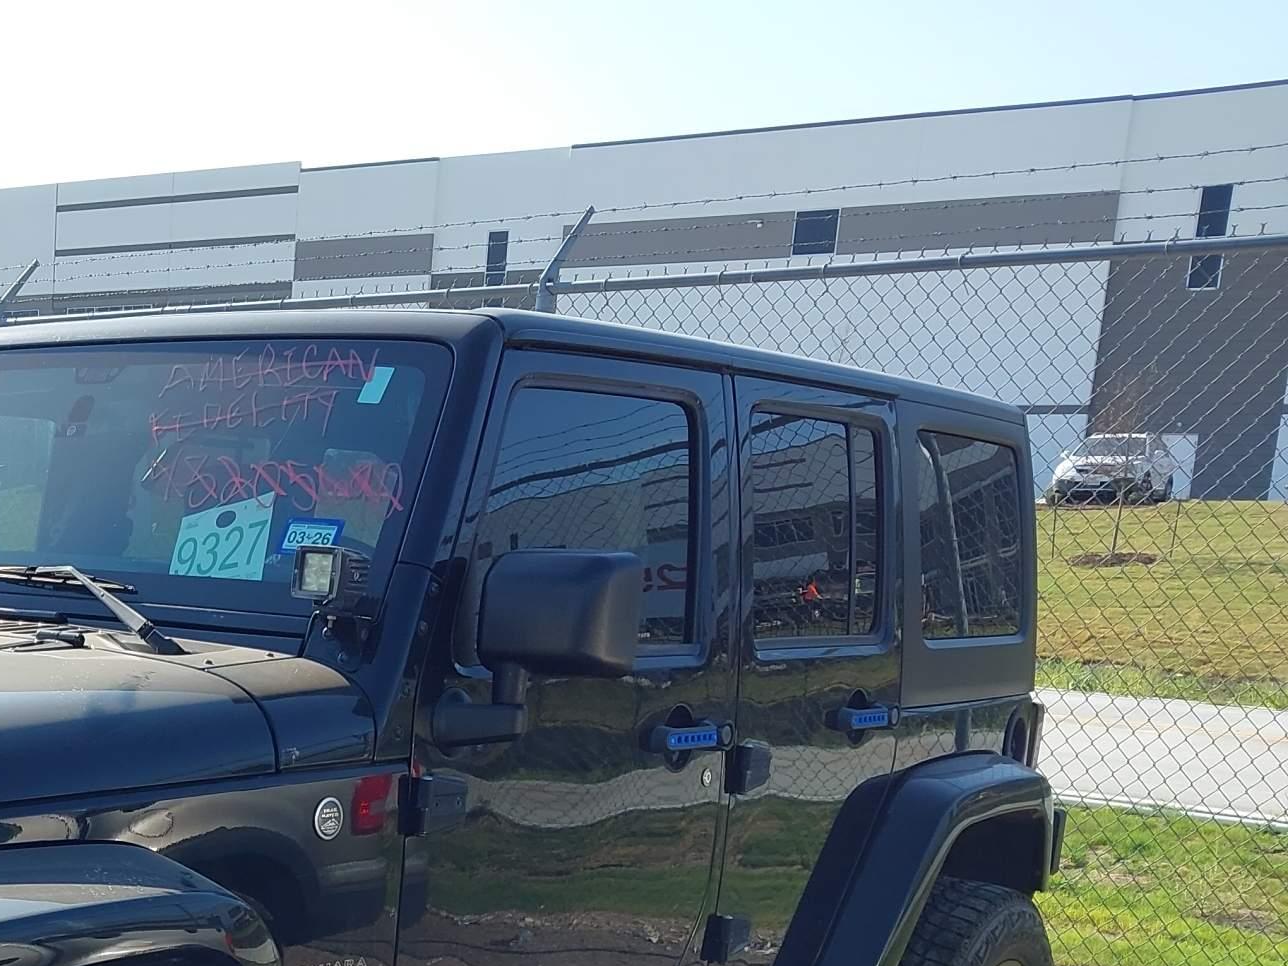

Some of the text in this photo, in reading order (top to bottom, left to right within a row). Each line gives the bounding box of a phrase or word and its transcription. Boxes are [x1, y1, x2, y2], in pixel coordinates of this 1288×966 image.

[158, 343, 380, 398] AMERICAN
[176, 519, 270, 576] 9327
[287, 530, 332, 545] 03 26
